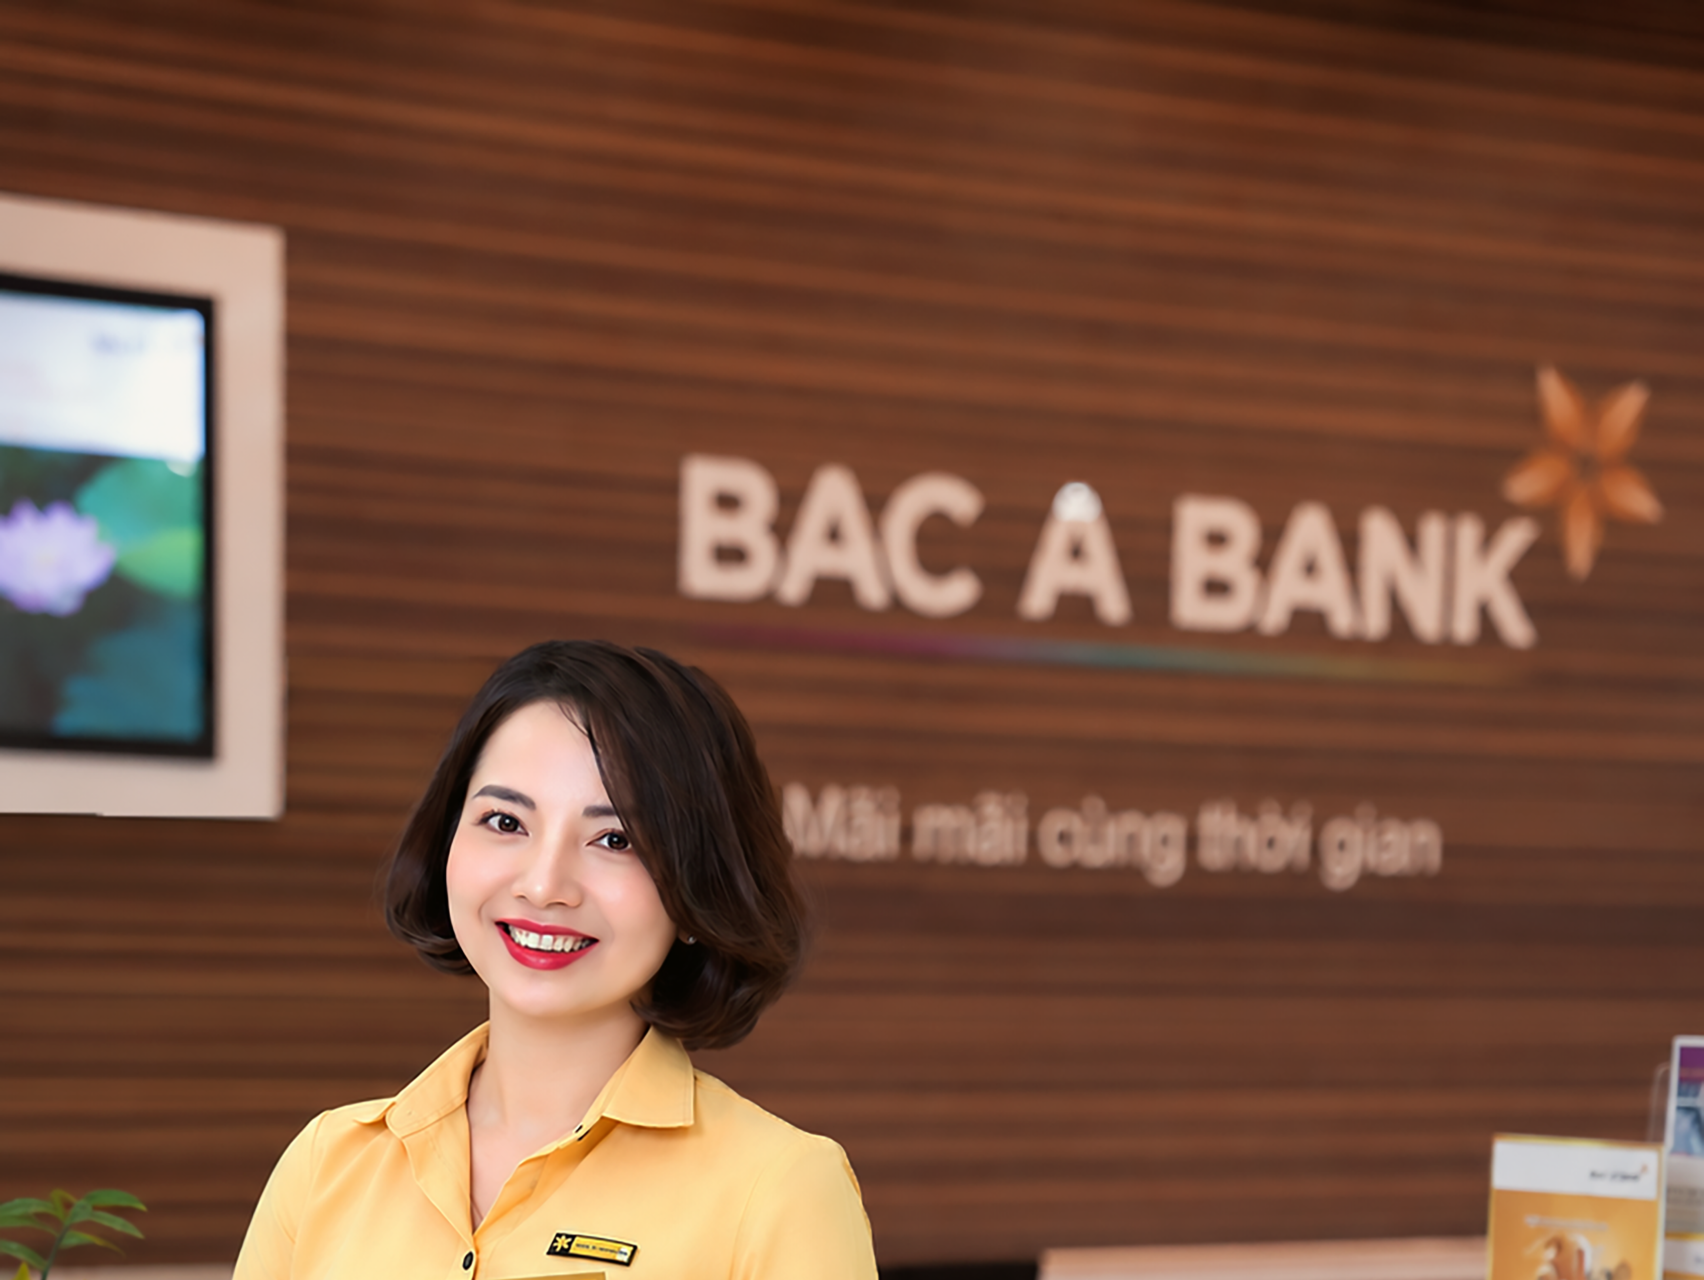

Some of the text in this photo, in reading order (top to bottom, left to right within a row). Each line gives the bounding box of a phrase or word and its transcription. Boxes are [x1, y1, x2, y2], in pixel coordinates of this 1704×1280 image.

[679, 454, 1542, 649] BAC A BANK
[1321, 802, 1441, 890] gian
